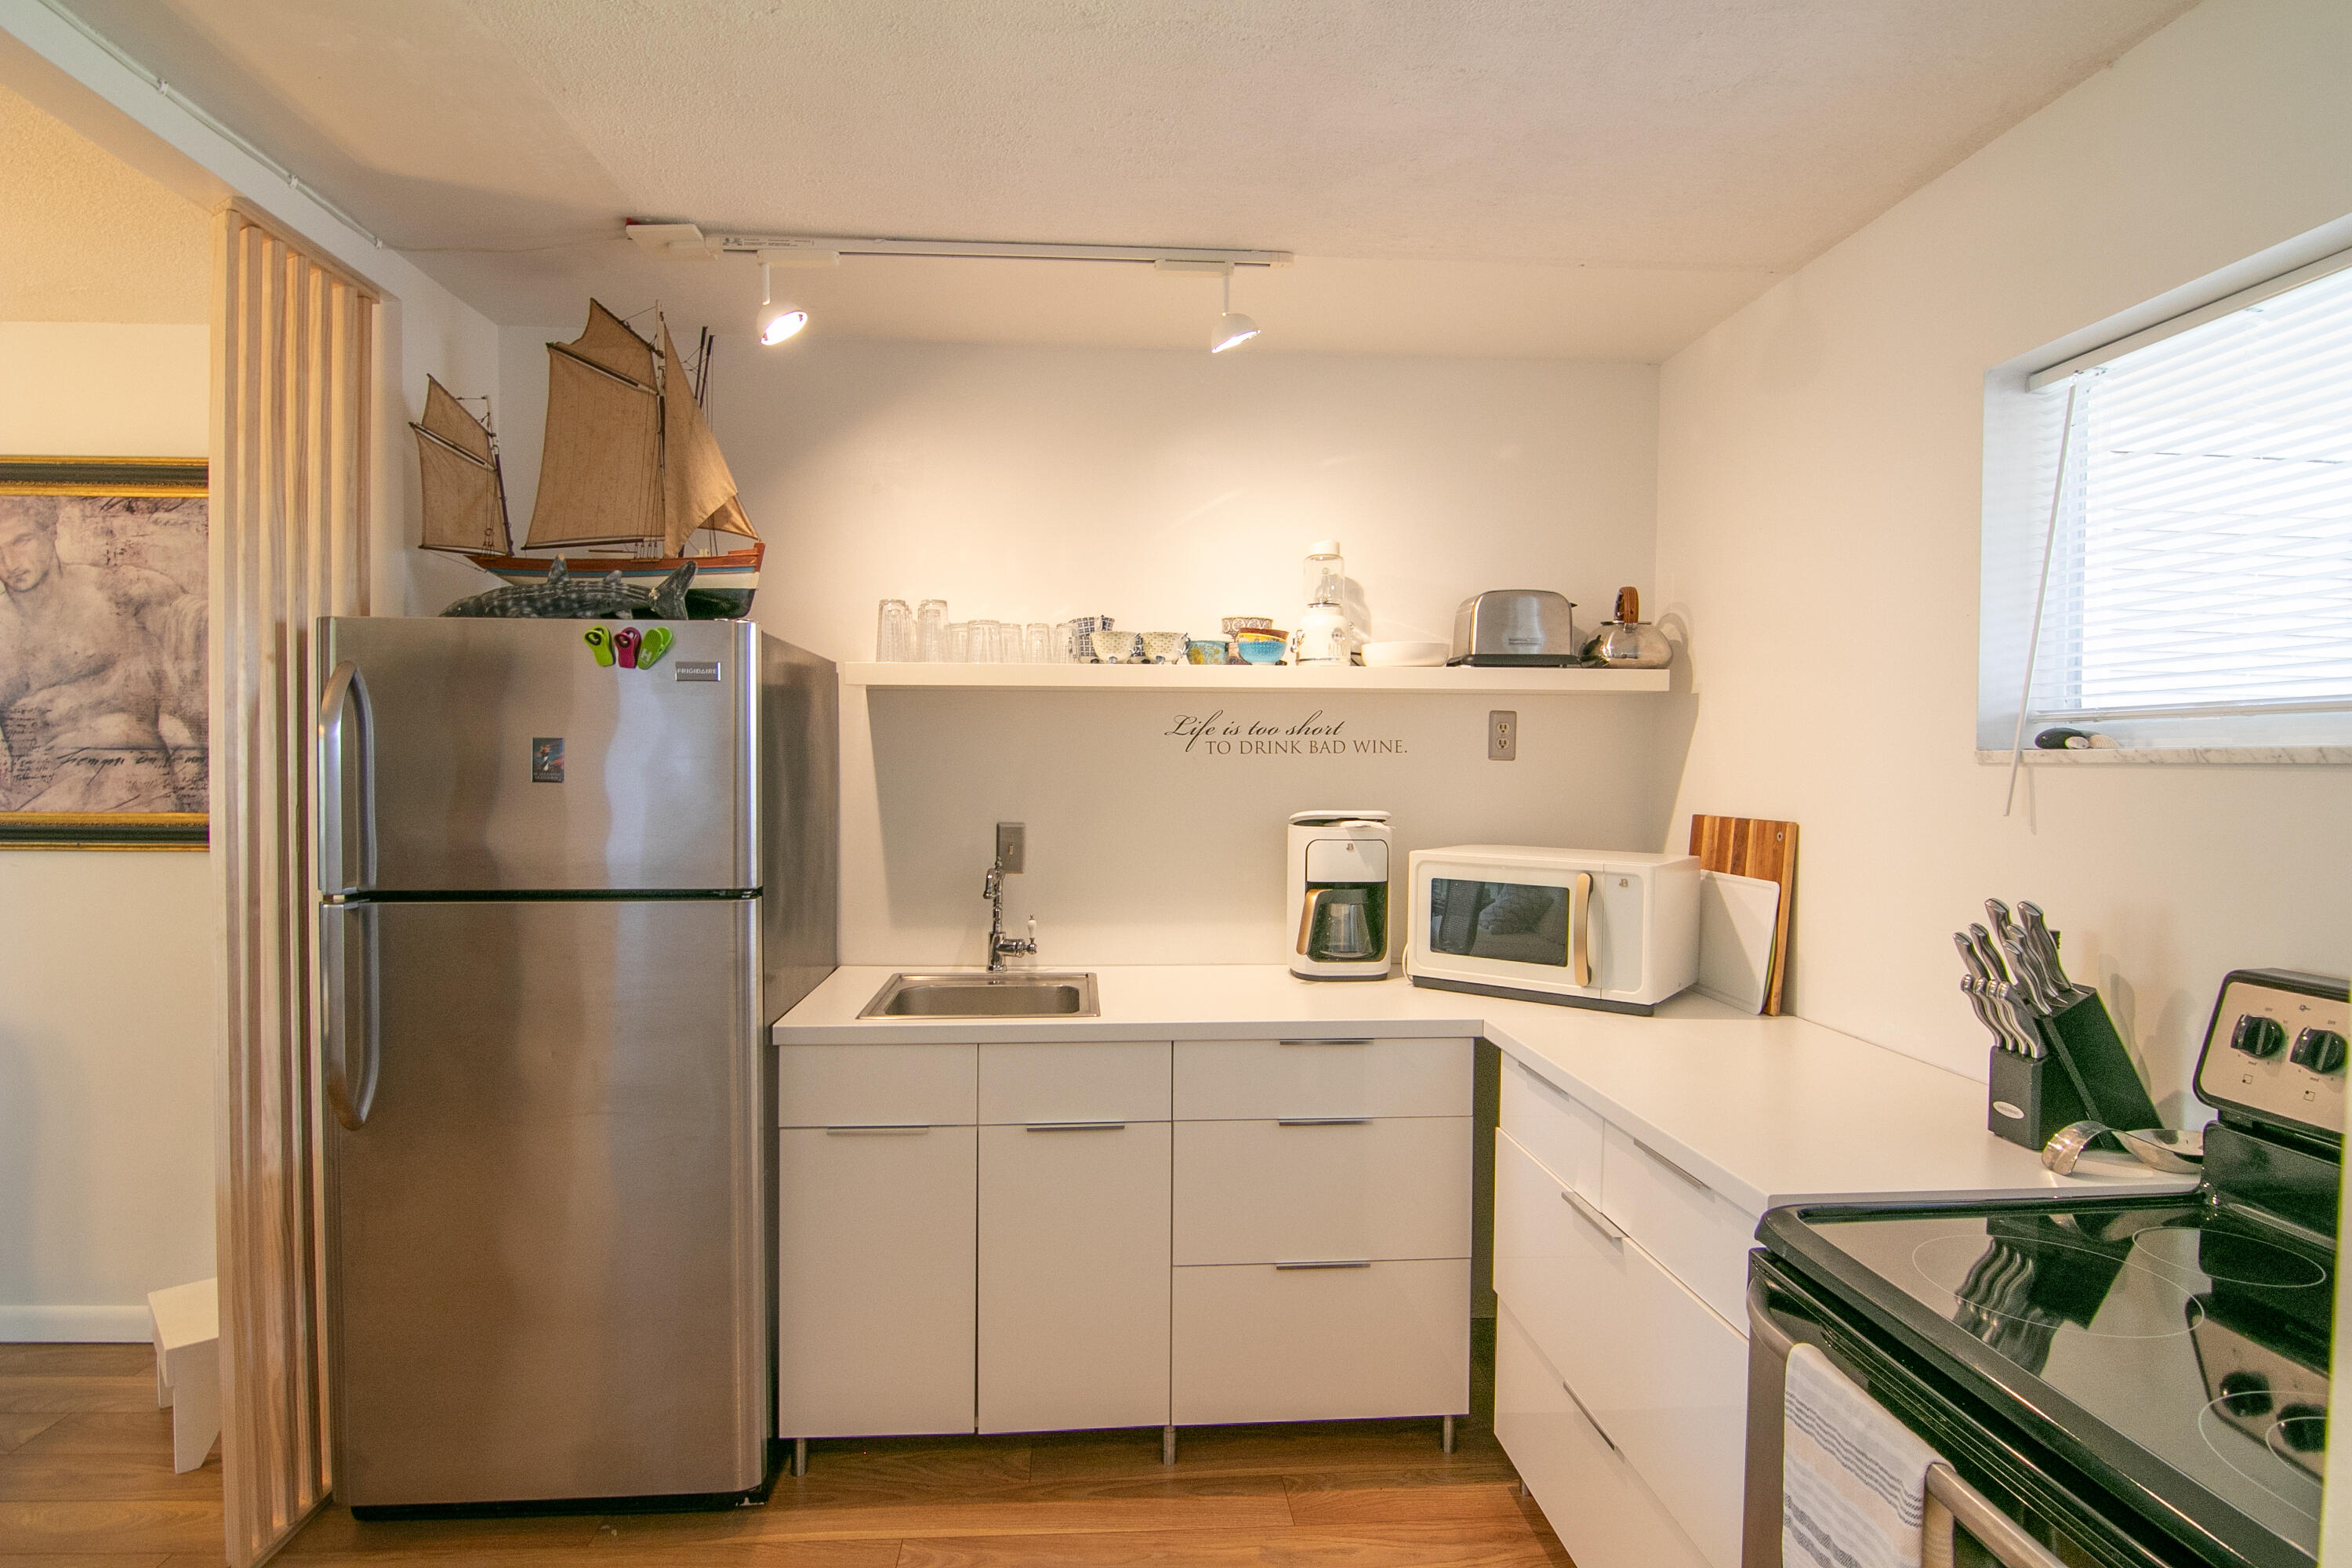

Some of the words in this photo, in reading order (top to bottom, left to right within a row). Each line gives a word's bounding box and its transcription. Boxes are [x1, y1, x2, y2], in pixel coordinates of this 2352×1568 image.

[1164, 710, 1224, 753] Life
[1222, 720, 1242, 735] is
[1248, 720, 1279, 735] too
[1285, 710, 1345, 735] short
[1205, 740, 1231, 754] TO
[1240, 740, 1302, 754] DRINK
[1309, 739, 1346, 753] BAD
[1353, 739, 1408, 753] WINE.
